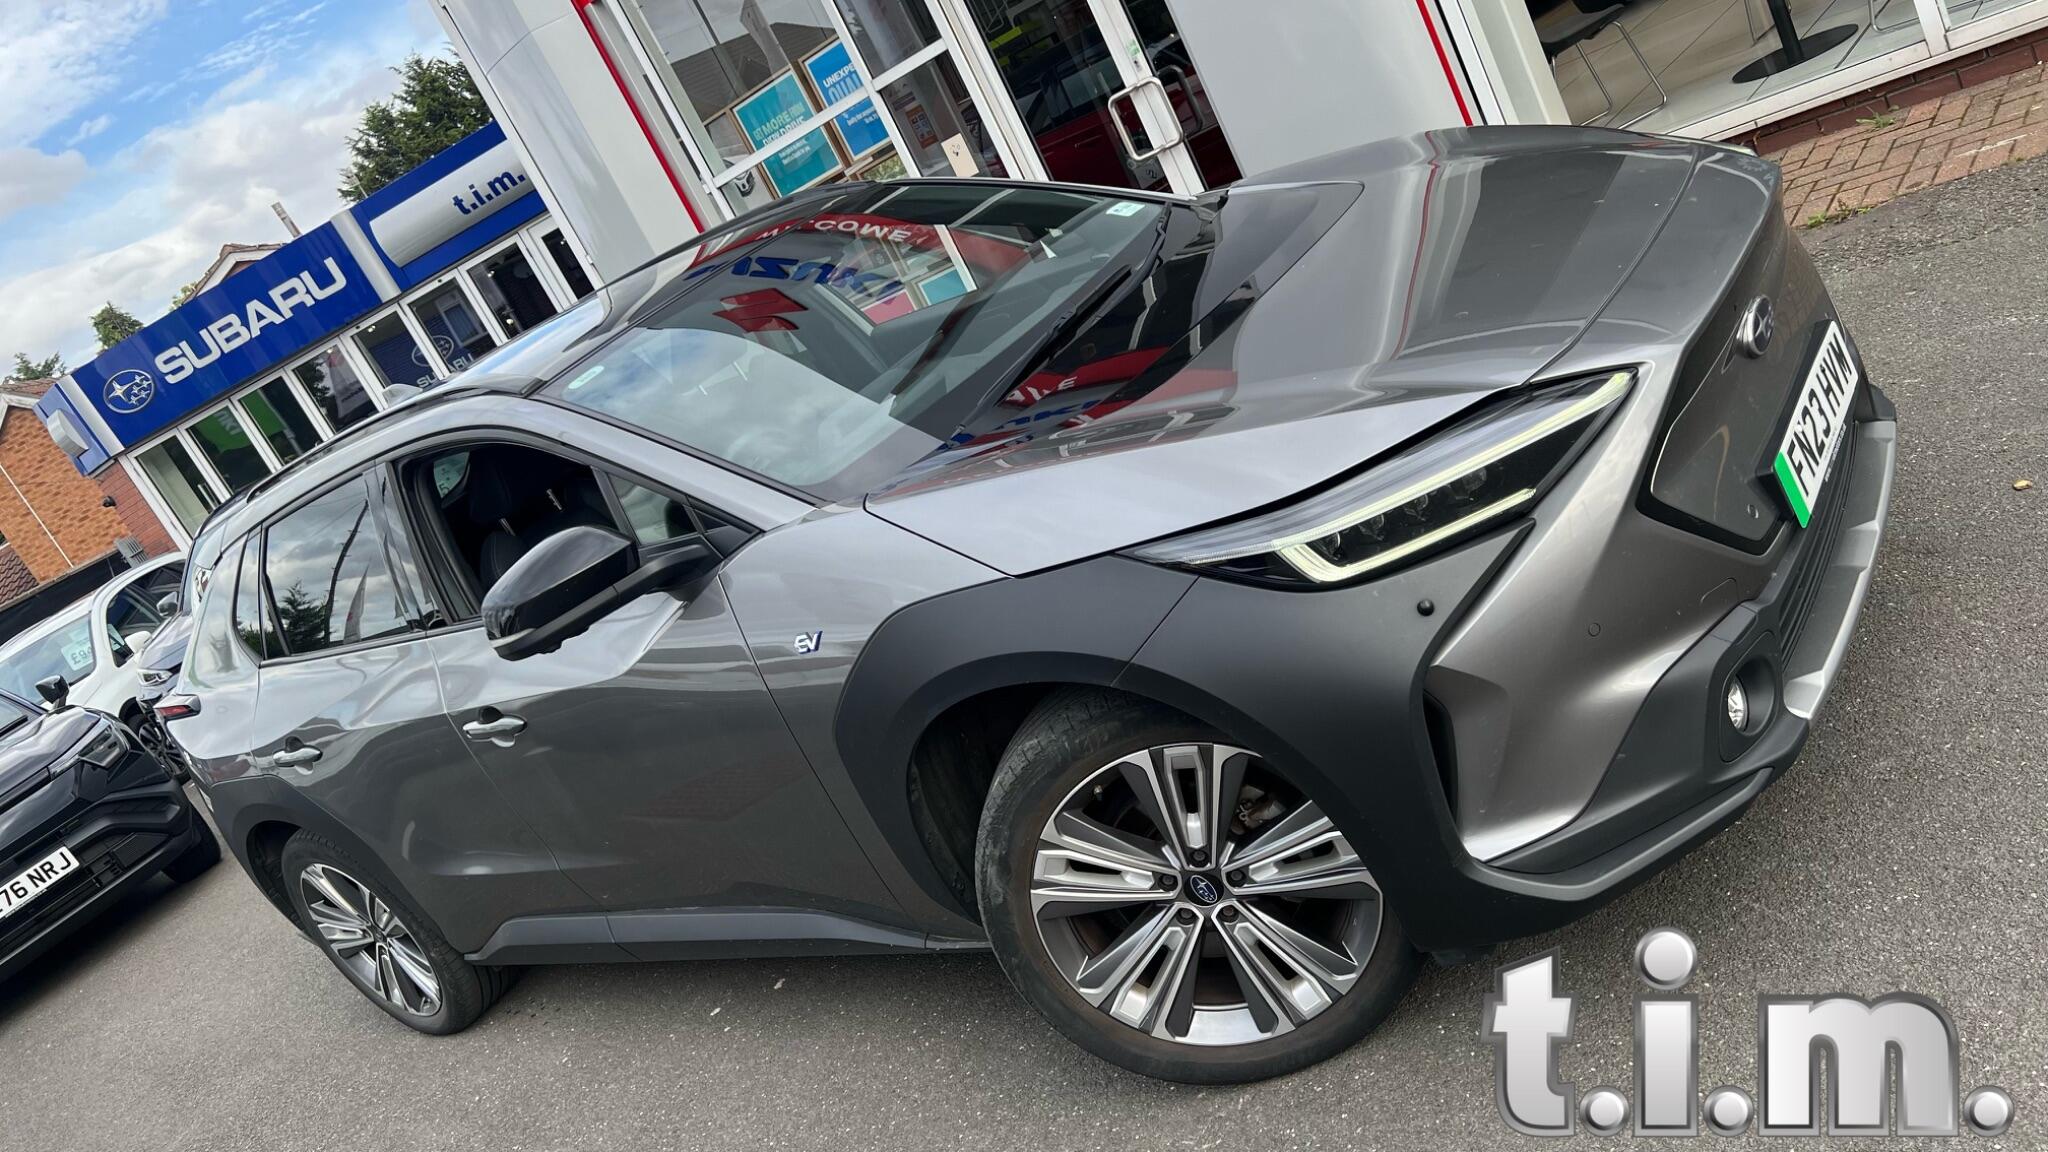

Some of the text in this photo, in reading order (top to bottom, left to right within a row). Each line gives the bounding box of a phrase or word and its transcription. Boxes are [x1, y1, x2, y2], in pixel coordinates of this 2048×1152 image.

[761, 110, 791, 134] MORE
[452, 170, 526, 215] t.i.m.
[154, 257, 347, 384] SUBARU
[1788, 388, 1831, 497] FN23
[1817, 333, 1852, 416] HVM
[794, 630, 823, 655] EV
[0, 881, 28, 913] 76
[26, 851, 72, 888] NRJ
